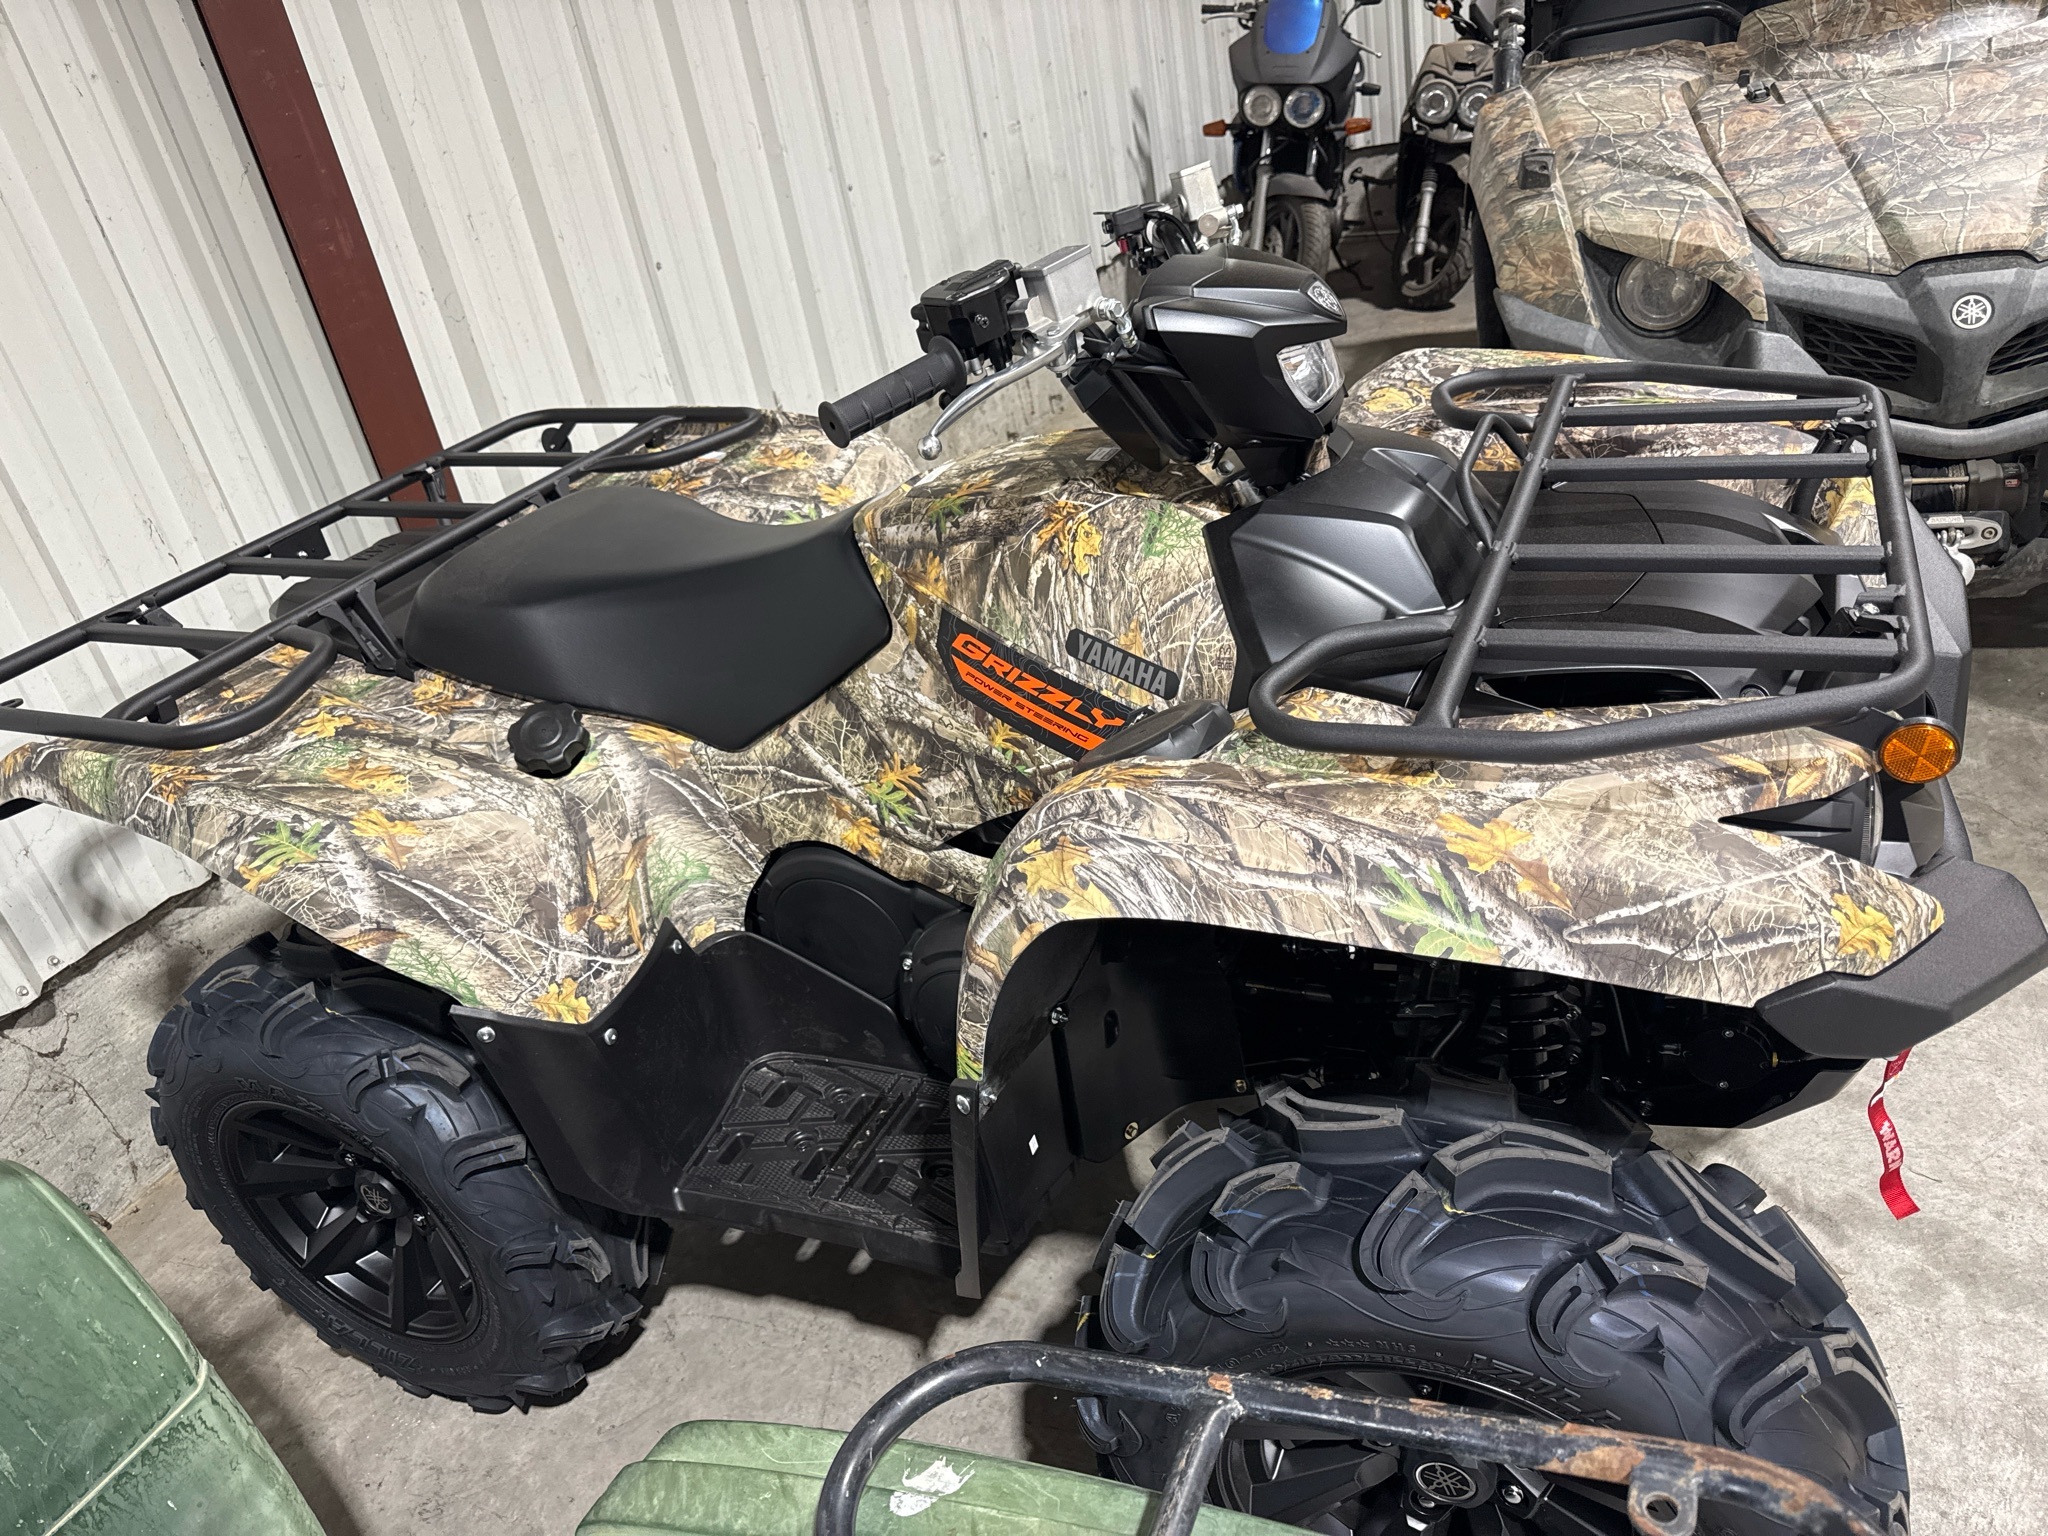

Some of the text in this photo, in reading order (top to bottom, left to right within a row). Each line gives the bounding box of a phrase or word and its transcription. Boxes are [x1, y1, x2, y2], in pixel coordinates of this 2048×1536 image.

[951, 633, 1126, 728] GRIZZLY
[1078, 634, 1168, 698] YAMAHA
[965, 670, 1090, 743] POWER STEERING
